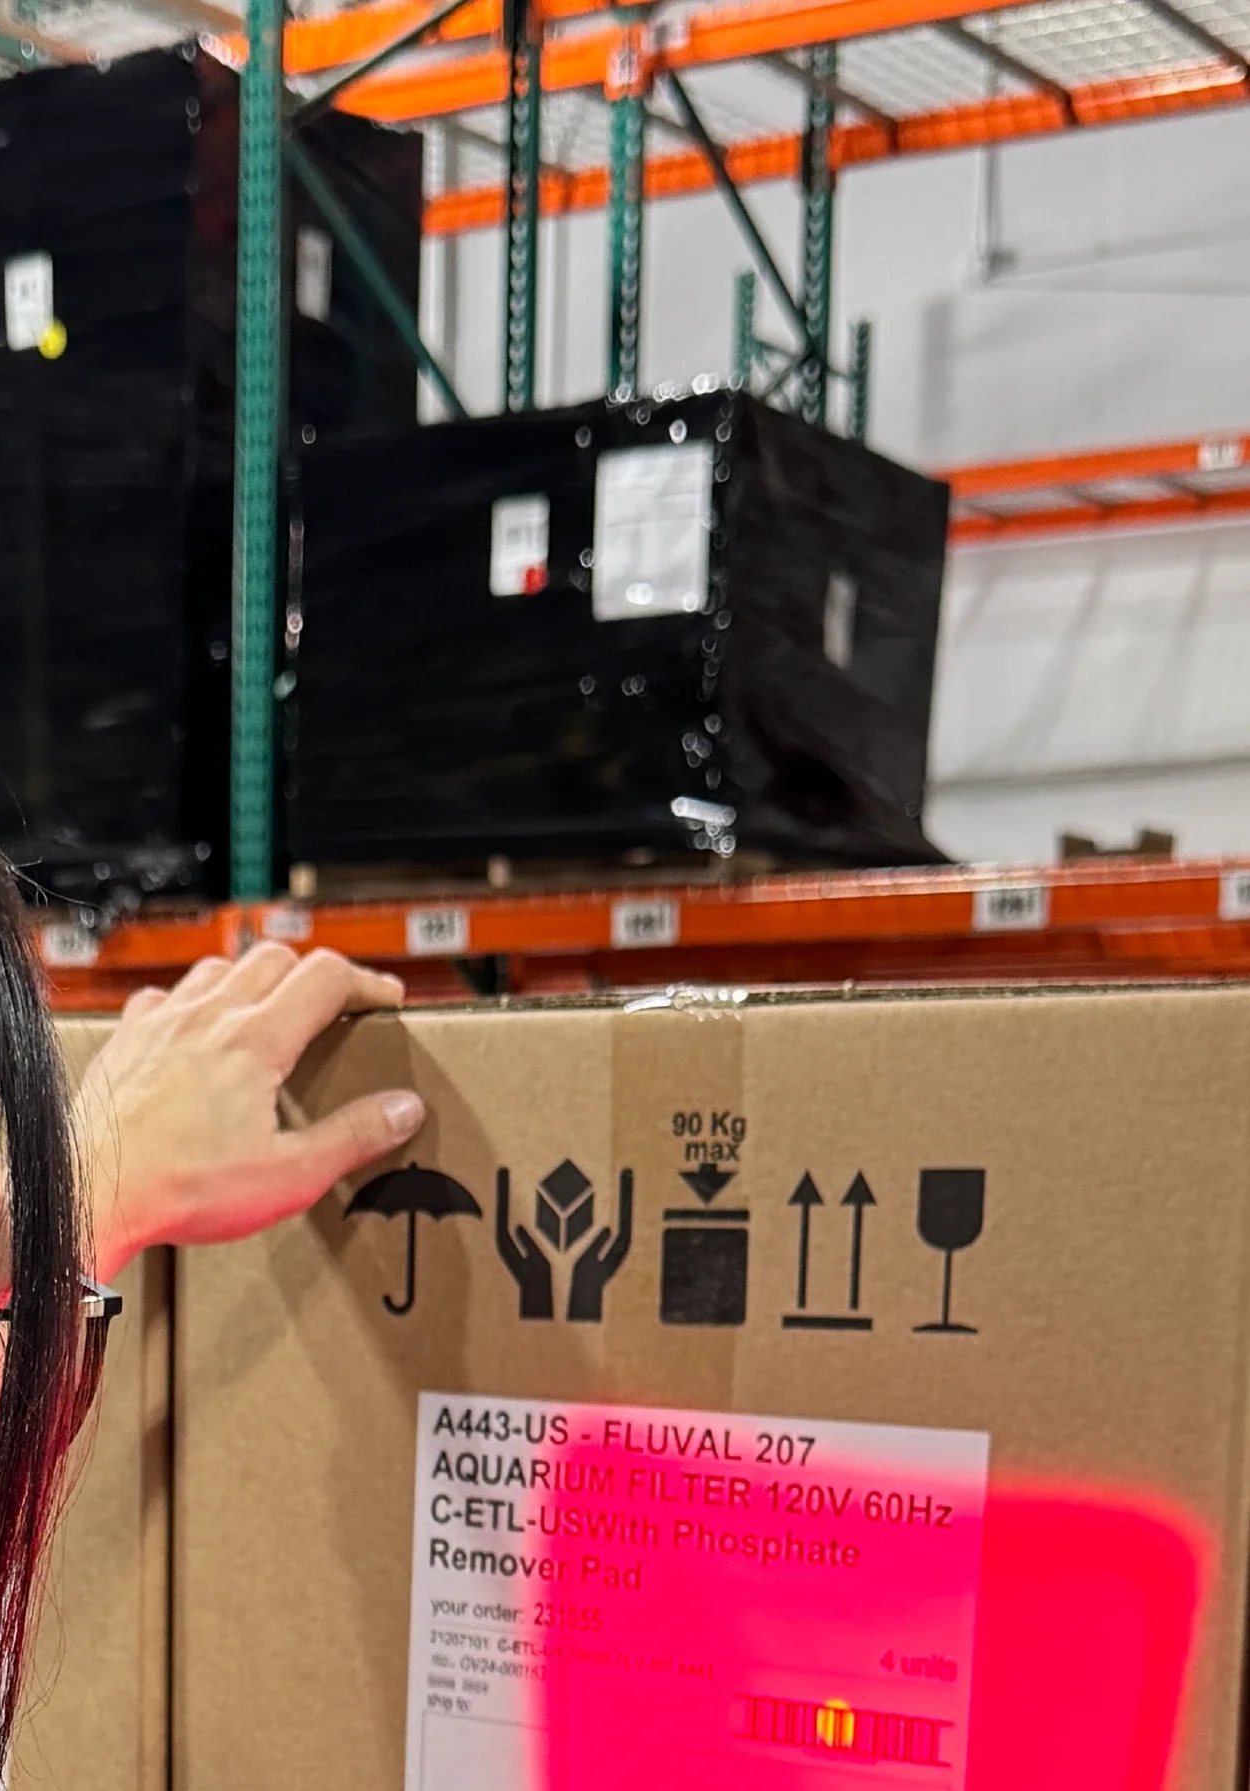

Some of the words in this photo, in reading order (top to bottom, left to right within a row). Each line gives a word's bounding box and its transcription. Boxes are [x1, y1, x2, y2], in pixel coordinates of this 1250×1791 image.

[672, 1111, 703, 1137] 90
[711, 1110, 747, 1143] Kg
[685, 1141, 740, 1162] max
[433, 1406, 569, 1446] A443-US
[602, 1419, 742, 1461] FLUVAL
[755, 1433, 816, 1466] 207
[431, 1450, 614, 1496] AQUARIUM
[627, 1468, 751, 1509] FILTER
[765, 1481, 852, 1518] 120V
[863, 1490, 953, 1529] 60Hz
[430, 1494, 659, 1546] C-ETL-USWith
[673, 1520, 859, 1568] Phosphate
[429, 1537, 568, 1583] Remover
[581, 1555, 642, 1590] Pad
[430, 1599, 468, 1618] your
[472, 1603, 525, 1623] order:
[534, 1602, 602, 1633] 231055
[879, 1650, 895, 1672] 4
[900, 1654, 958, 1682] units
